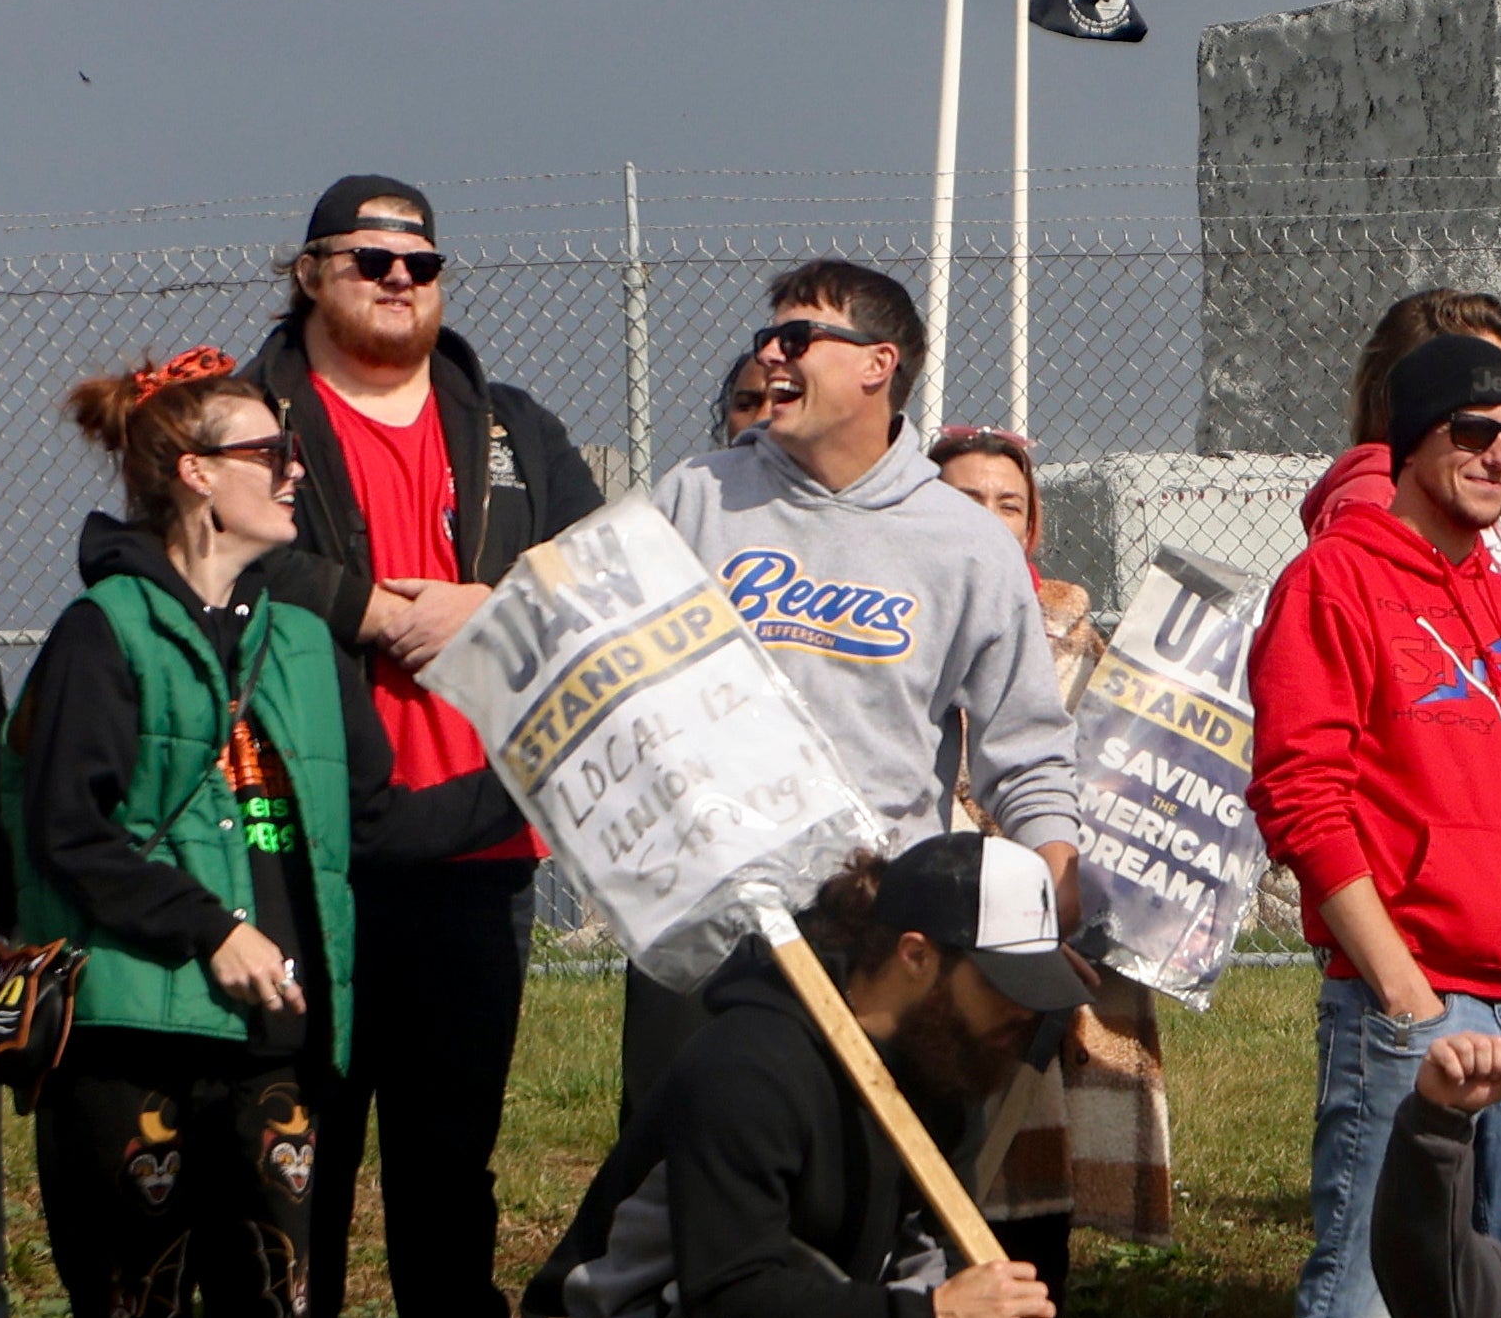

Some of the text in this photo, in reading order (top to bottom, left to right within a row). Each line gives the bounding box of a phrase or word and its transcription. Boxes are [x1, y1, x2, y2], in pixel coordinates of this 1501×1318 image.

[472, 523, 646, 694] UAW
[722, 550, 914, 632] Bears
[760, 624, 836, 648] JEFFERSON
[519, 604, 714, 772] STAND UP
[1154, 585, 1251, 700] UA
[558, 682, 750, 829] LOCAL 12
[1105, 667, 1233, 747] STAND
[1097, 738, 1245, 828] SAVING
[1151, 795, 1177, 816] THE
[1081, 783, 1252, 890] MERICAN
